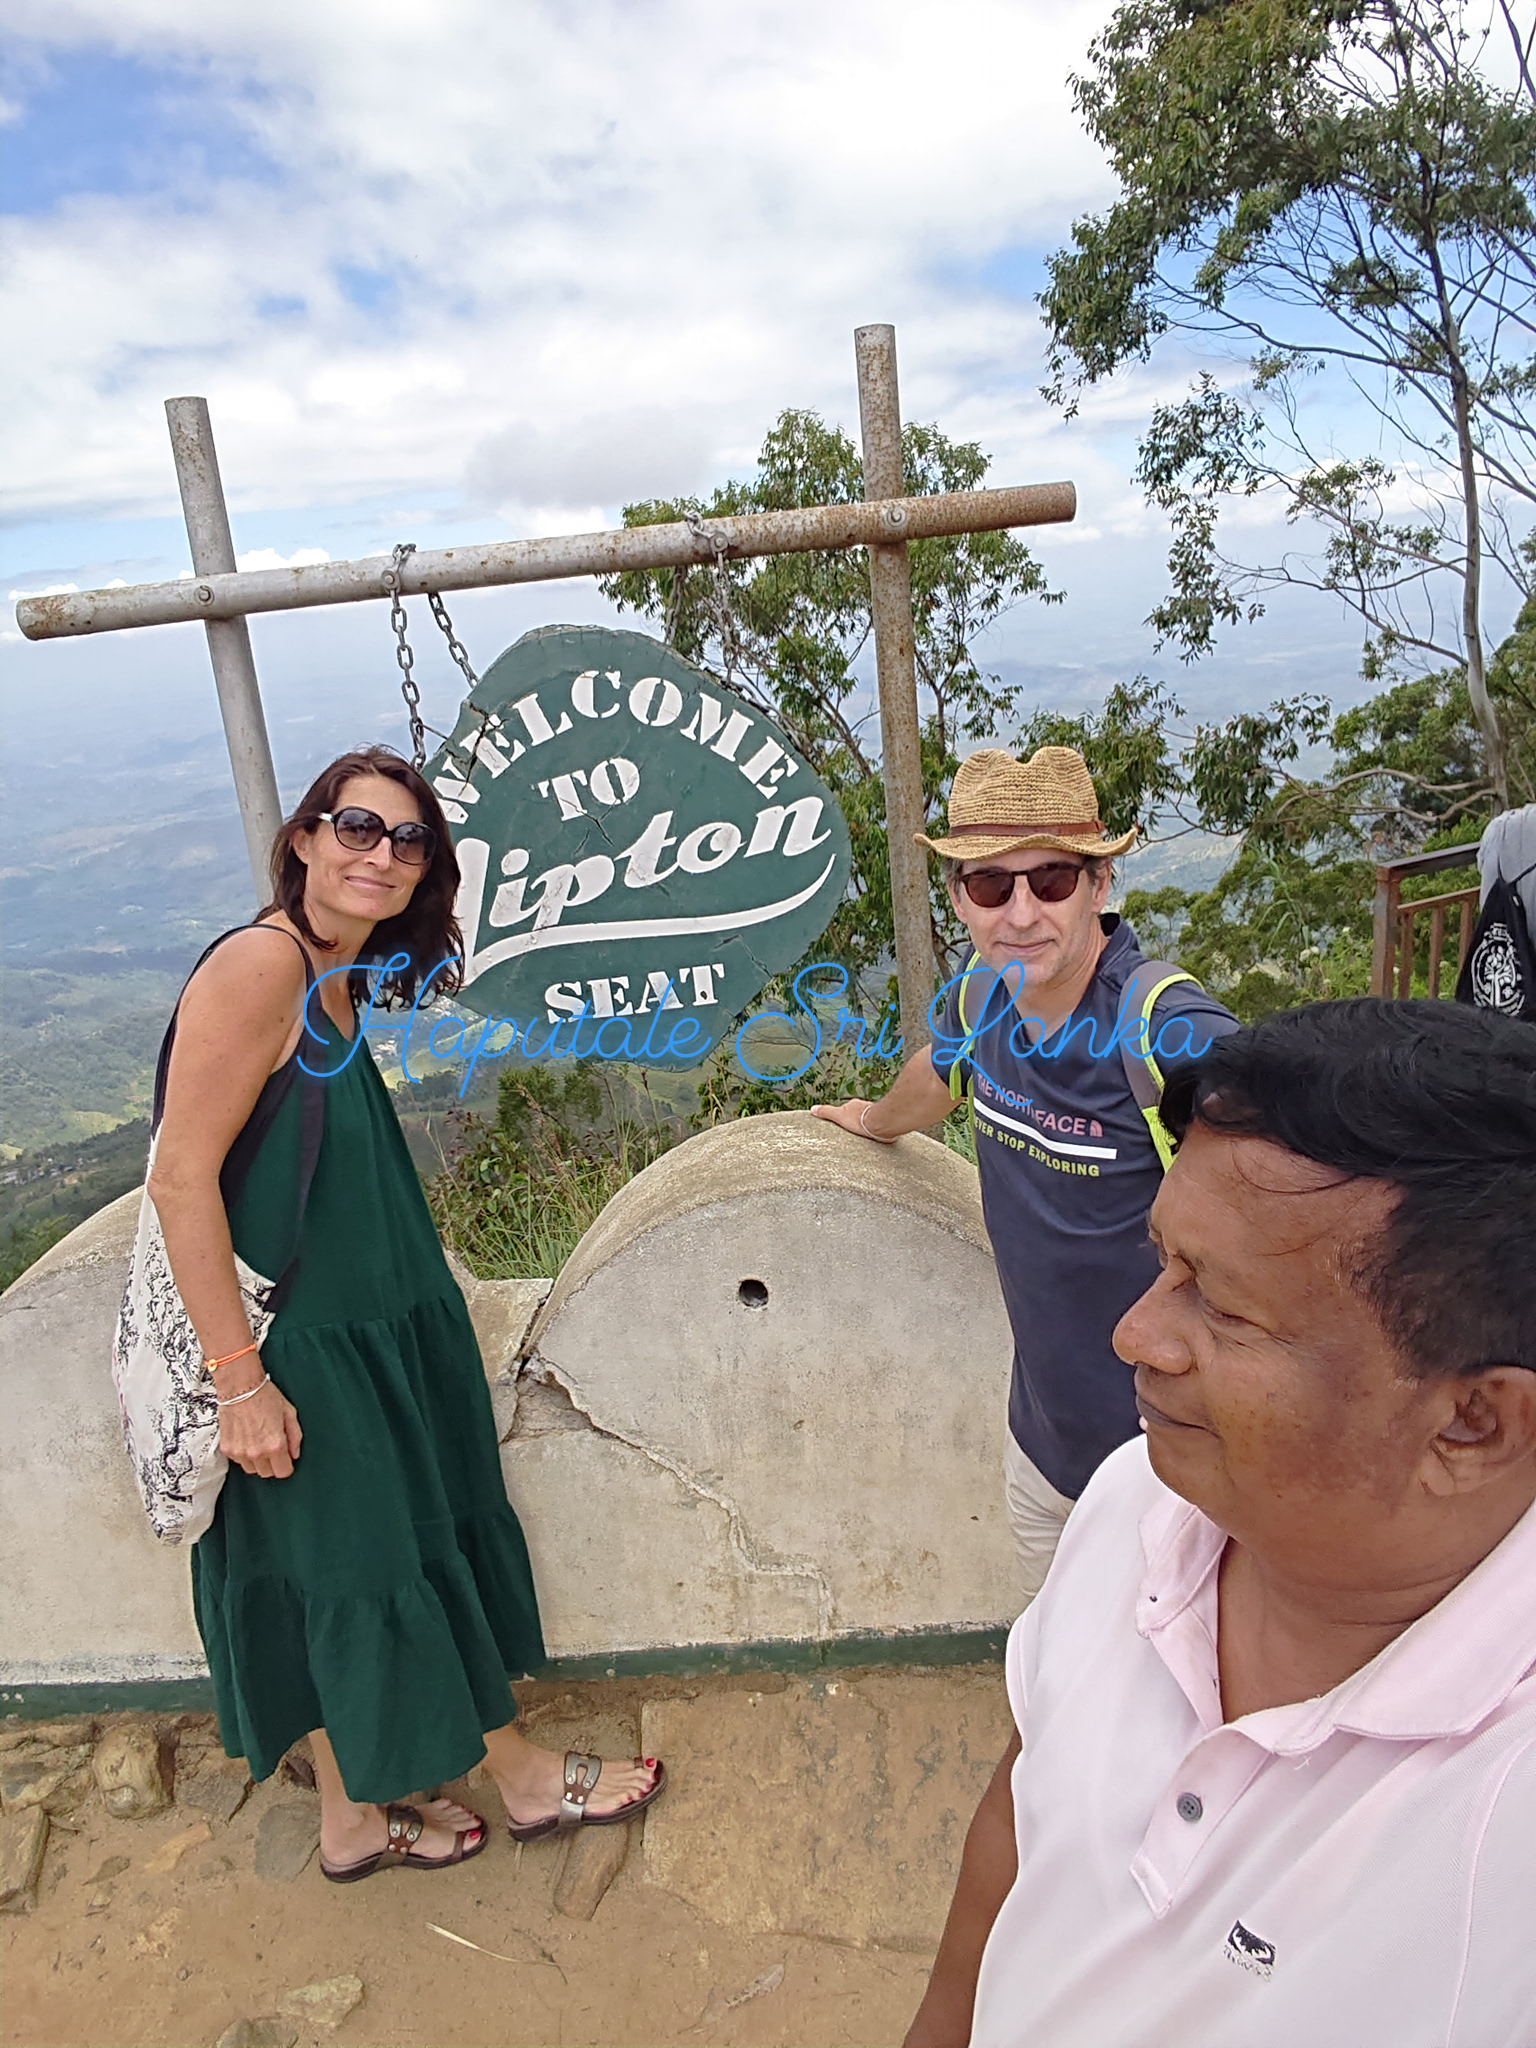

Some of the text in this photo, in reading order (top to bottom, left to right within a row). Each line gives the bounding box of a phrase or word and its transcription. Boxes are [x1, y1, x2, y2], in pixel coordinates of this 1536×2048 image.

[432, 670, 800, 825] WELCOME
[536, 757, 641, 822] TO
[544, 962, 726, 1025] SEAT
[977, 1072, 994, 1098] THE
[1035, 1109, 1087, 1136] FACE
[974, 1115, 1100, 1177] EVER STOP EXPLORING
